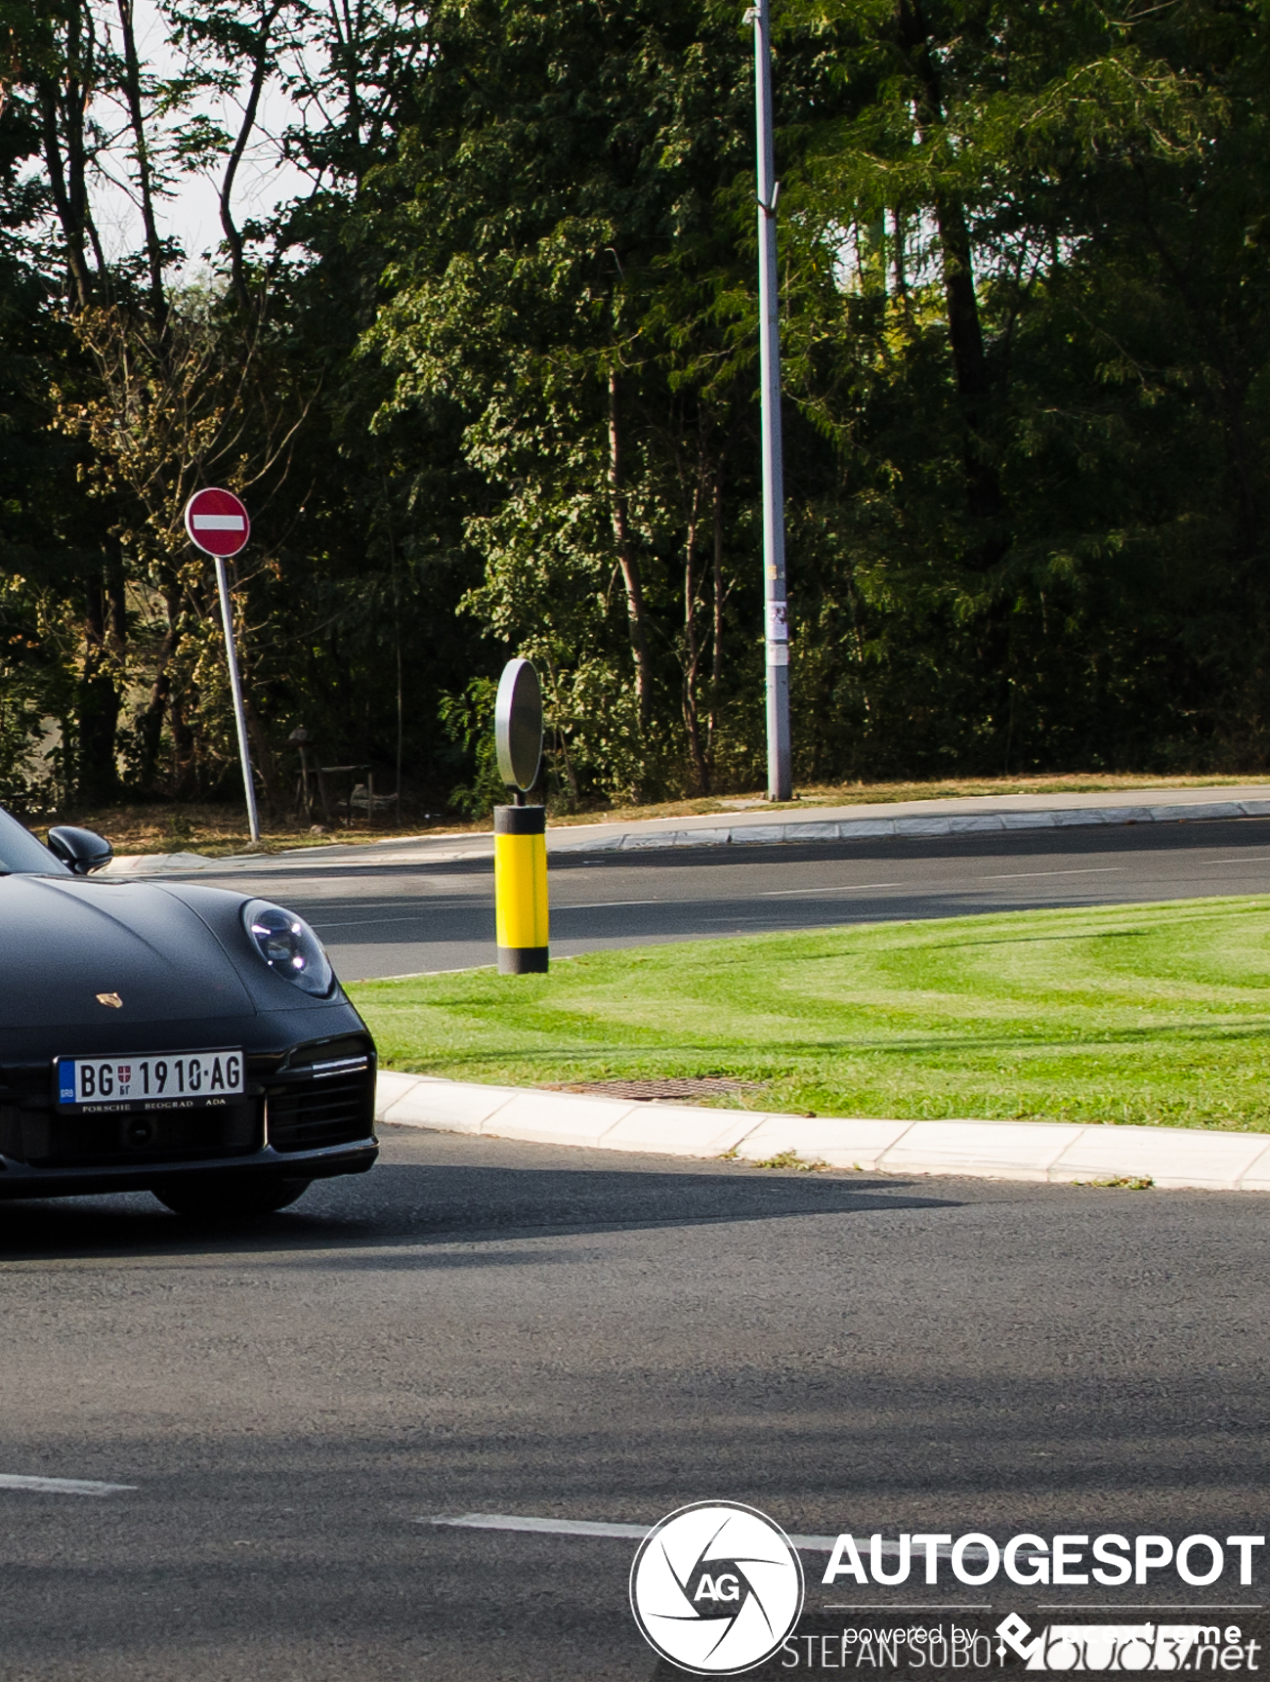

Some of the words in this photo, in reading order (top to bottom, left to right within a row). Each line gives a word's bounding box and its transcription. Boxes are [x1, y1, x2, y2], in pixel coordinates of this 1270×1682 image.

[80, 1063, 113, 1098] BG
[82, 1103, 131, 1113] PORSCHE
[144, 1100, 194, 1110] BEOGRAD
[205, 1098, 226, 1107] ADA
